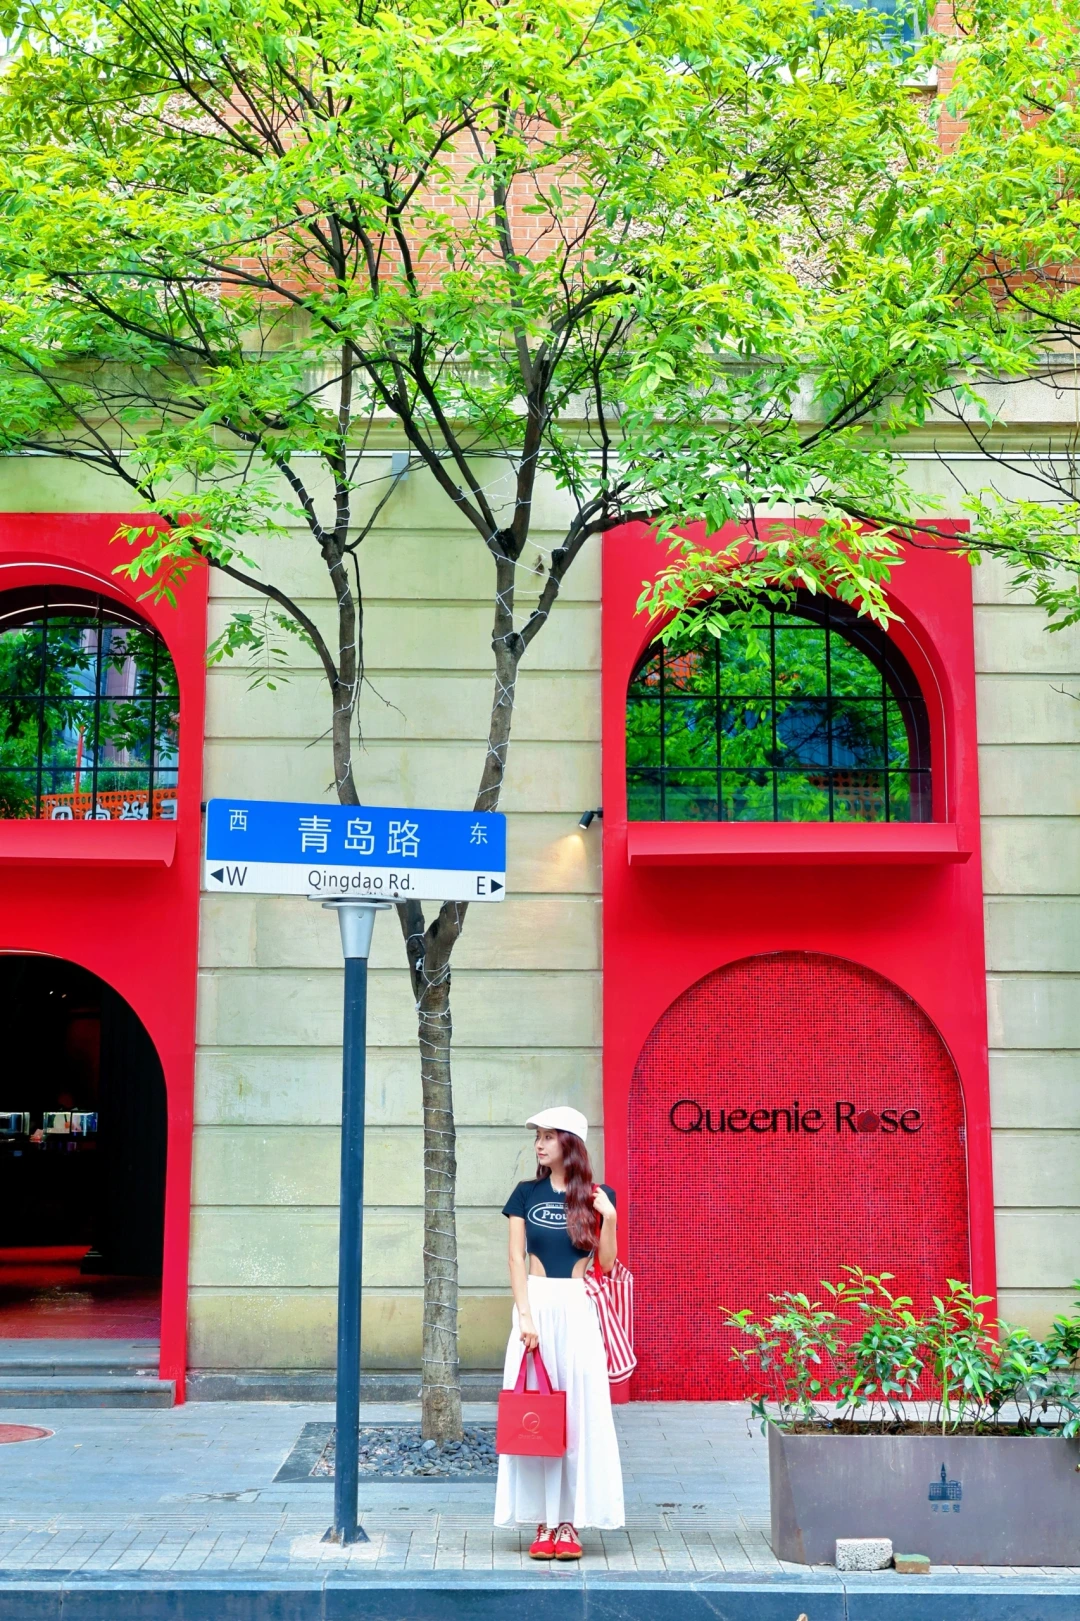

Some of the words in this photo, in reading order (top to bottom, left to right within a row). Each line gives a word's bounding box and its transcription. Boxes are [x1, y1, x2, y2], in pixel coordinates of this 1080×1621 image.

[228, 809, 249, 832] 西
[298, 815, 421, 858] 青岛路
[469, 822, 488, 845] 东
[226, 866, 248, 886] W
[308, 870, 383, 893] Qingdao
[389, 873, 415, 891] Rd.
[476, 876, 486, 895] E
[669, 1099, 825, 1133] Queenie
